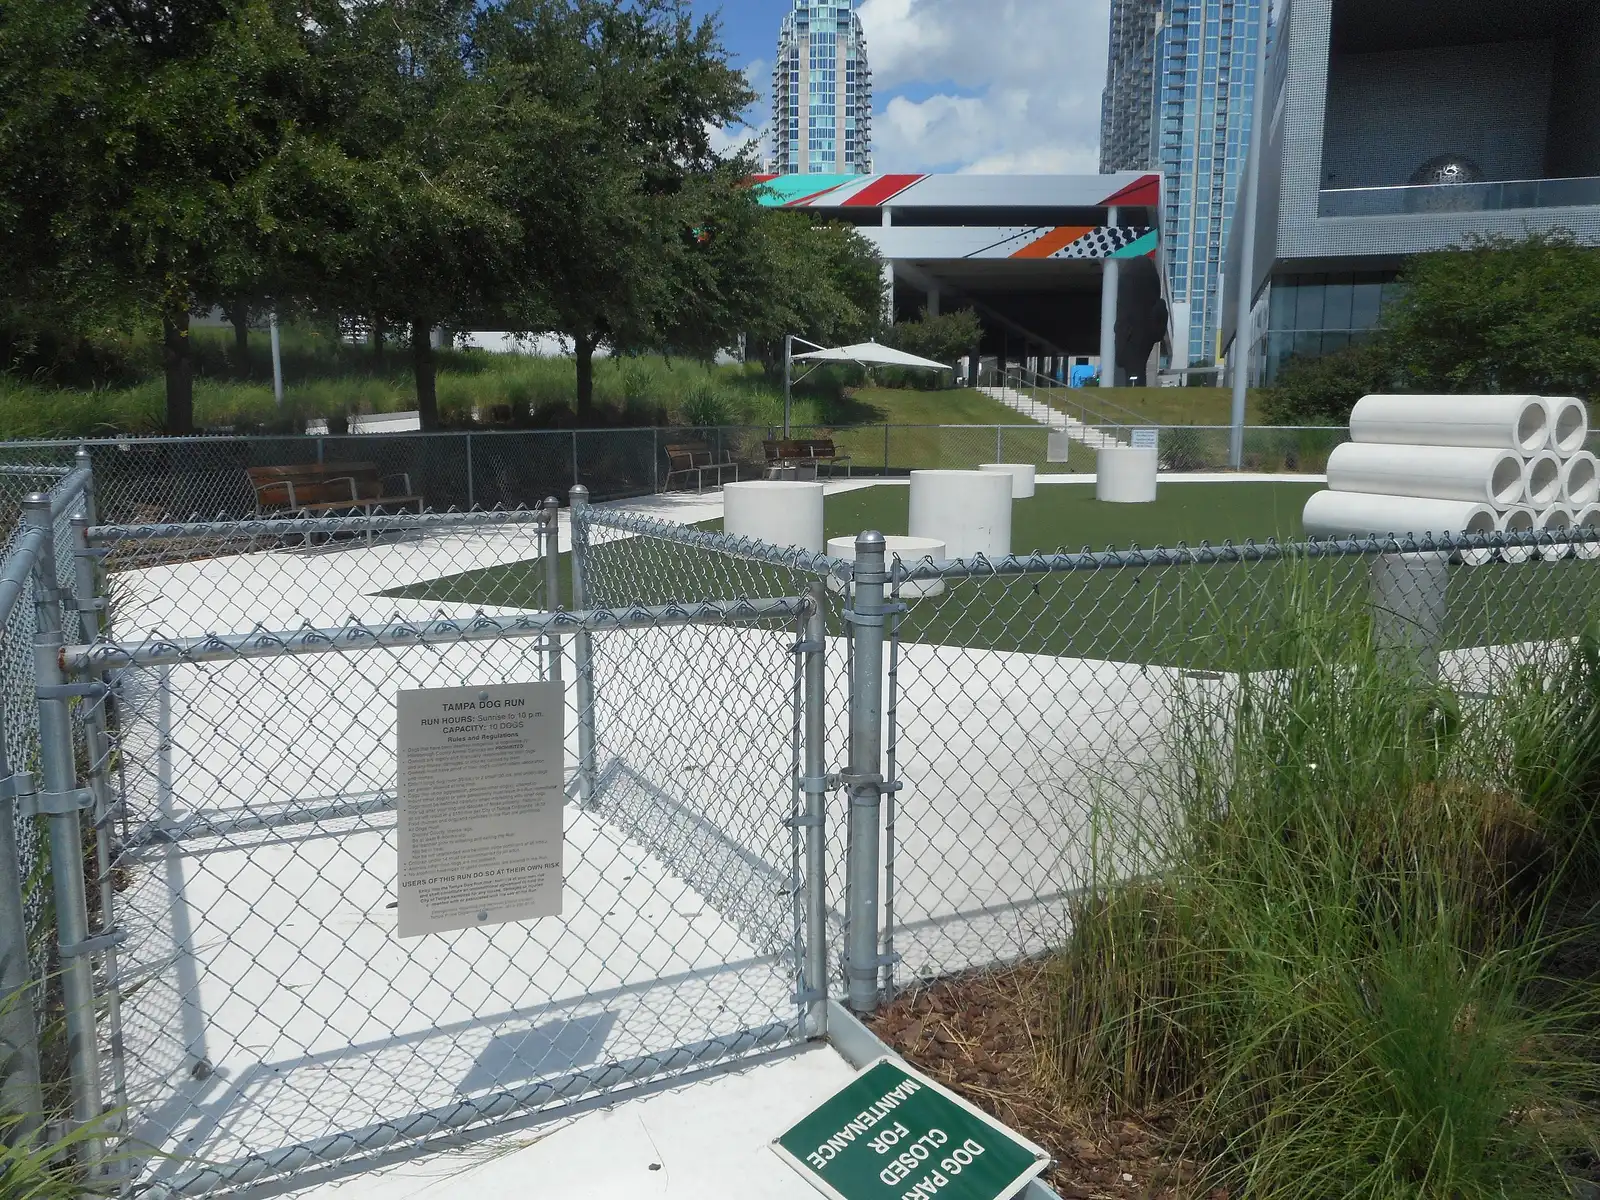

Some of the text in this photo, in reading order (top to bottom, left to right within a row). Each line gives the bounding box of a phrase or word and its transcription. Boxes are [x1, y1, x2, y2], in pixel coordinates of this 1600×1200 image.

[421, 717, 439, 726] RUN
[442, 715, 475, 725] HOURS:
[478, 713, 506, 722] Sunrise
[518, 711, 526, 719] 10
[442, 698, 525, 712] TAMPA DOG RUN
[443, 724, 486, 734] CAPACITY:
[500, 721, 523, 730] DOGS
[482, 731, 518, 741] Regulations
[403, 879, 426, 888] USERS
[440, 875, 455, 884] THIS
[457, 873, 472, 881] RUN
[507, 866, 525, 874] THEIR
[527, 864, 543, 872] OWN
[545, 861, 559, 869] RISK
[806, 1078, 921, 1170] MAINTENANCE
[867, 1121, 910, 1155] FOR
[879, 1128, 948, 1186] CLOSED
[901, 1138, 985, 1200] DOG PAR
